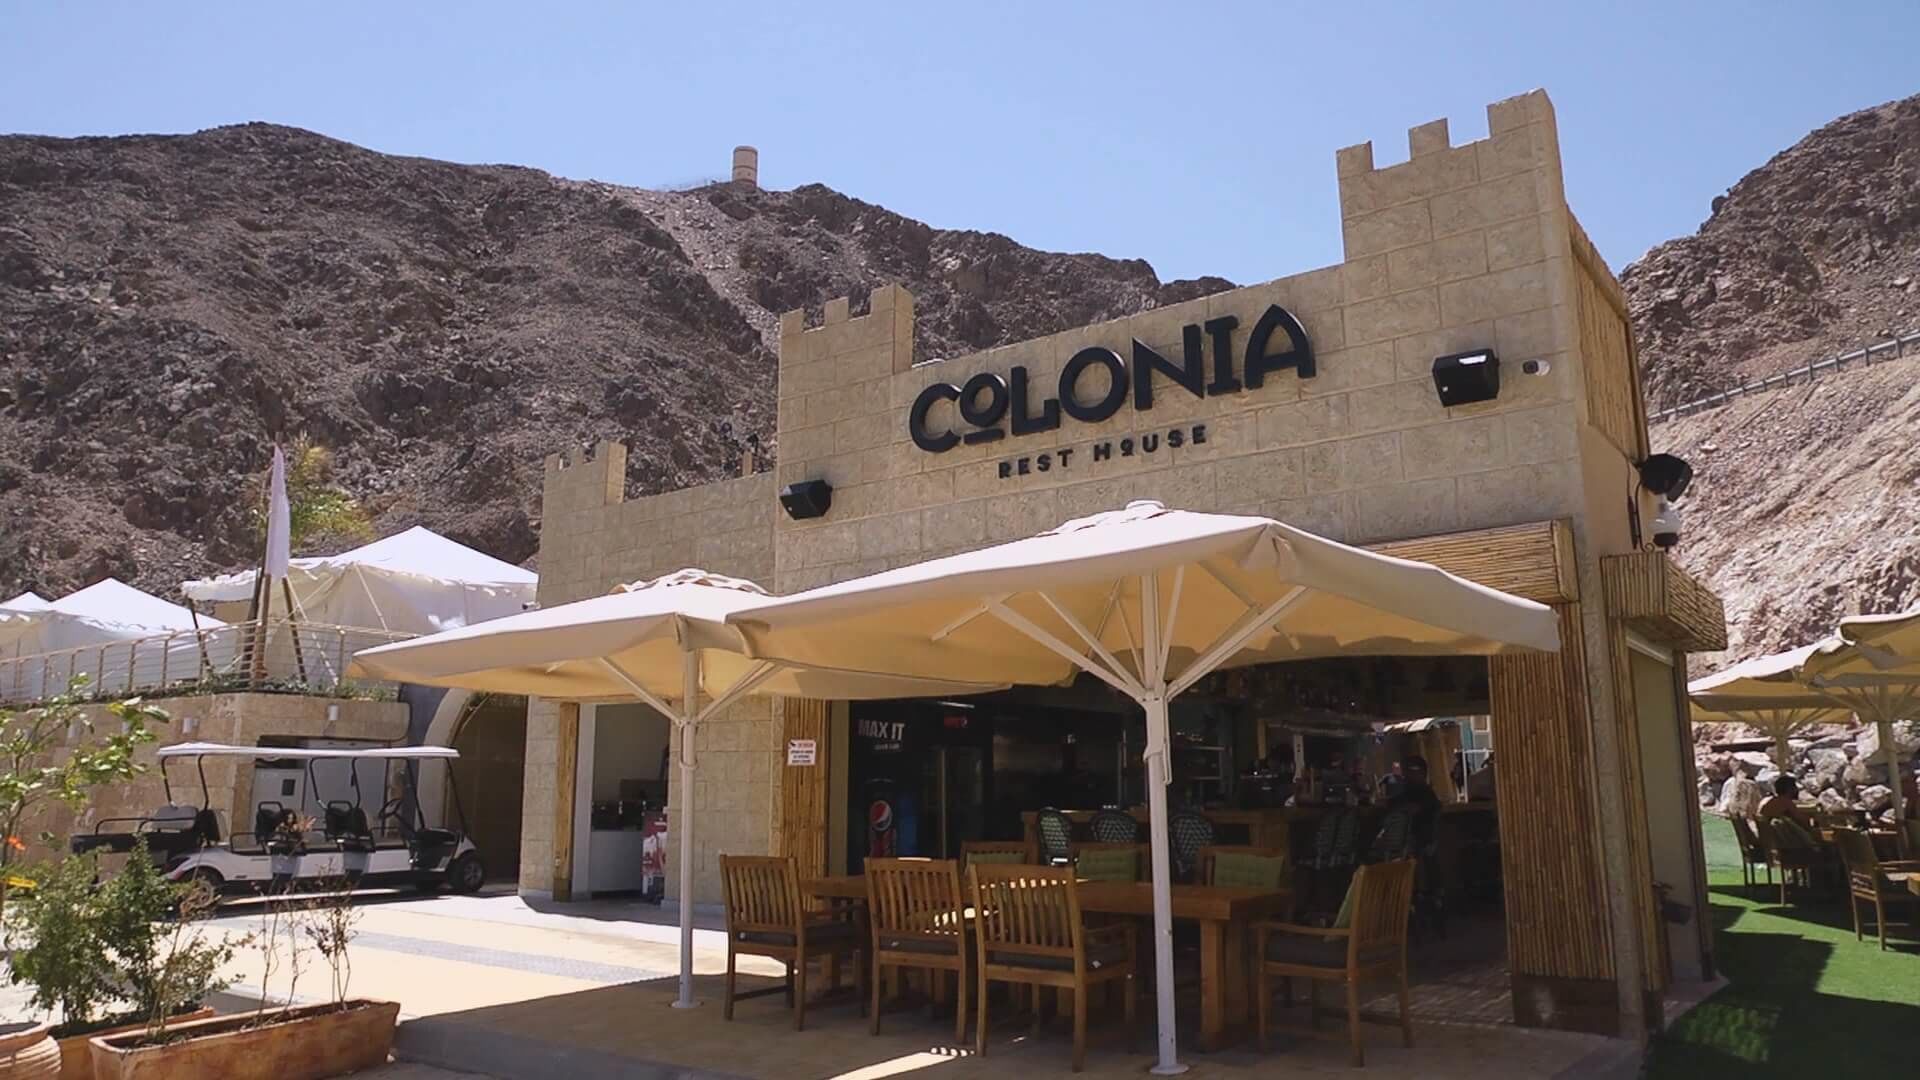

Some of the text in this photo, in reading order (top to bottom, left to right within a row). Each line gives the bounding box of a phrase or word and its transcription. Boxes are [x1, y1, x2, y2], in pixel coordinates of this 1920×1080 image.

[909, 304, 1317, 453] COLONIA
[998, 425, 1207, 479] REST HOUSE
[858, 719, 906, 741] MAX IT
